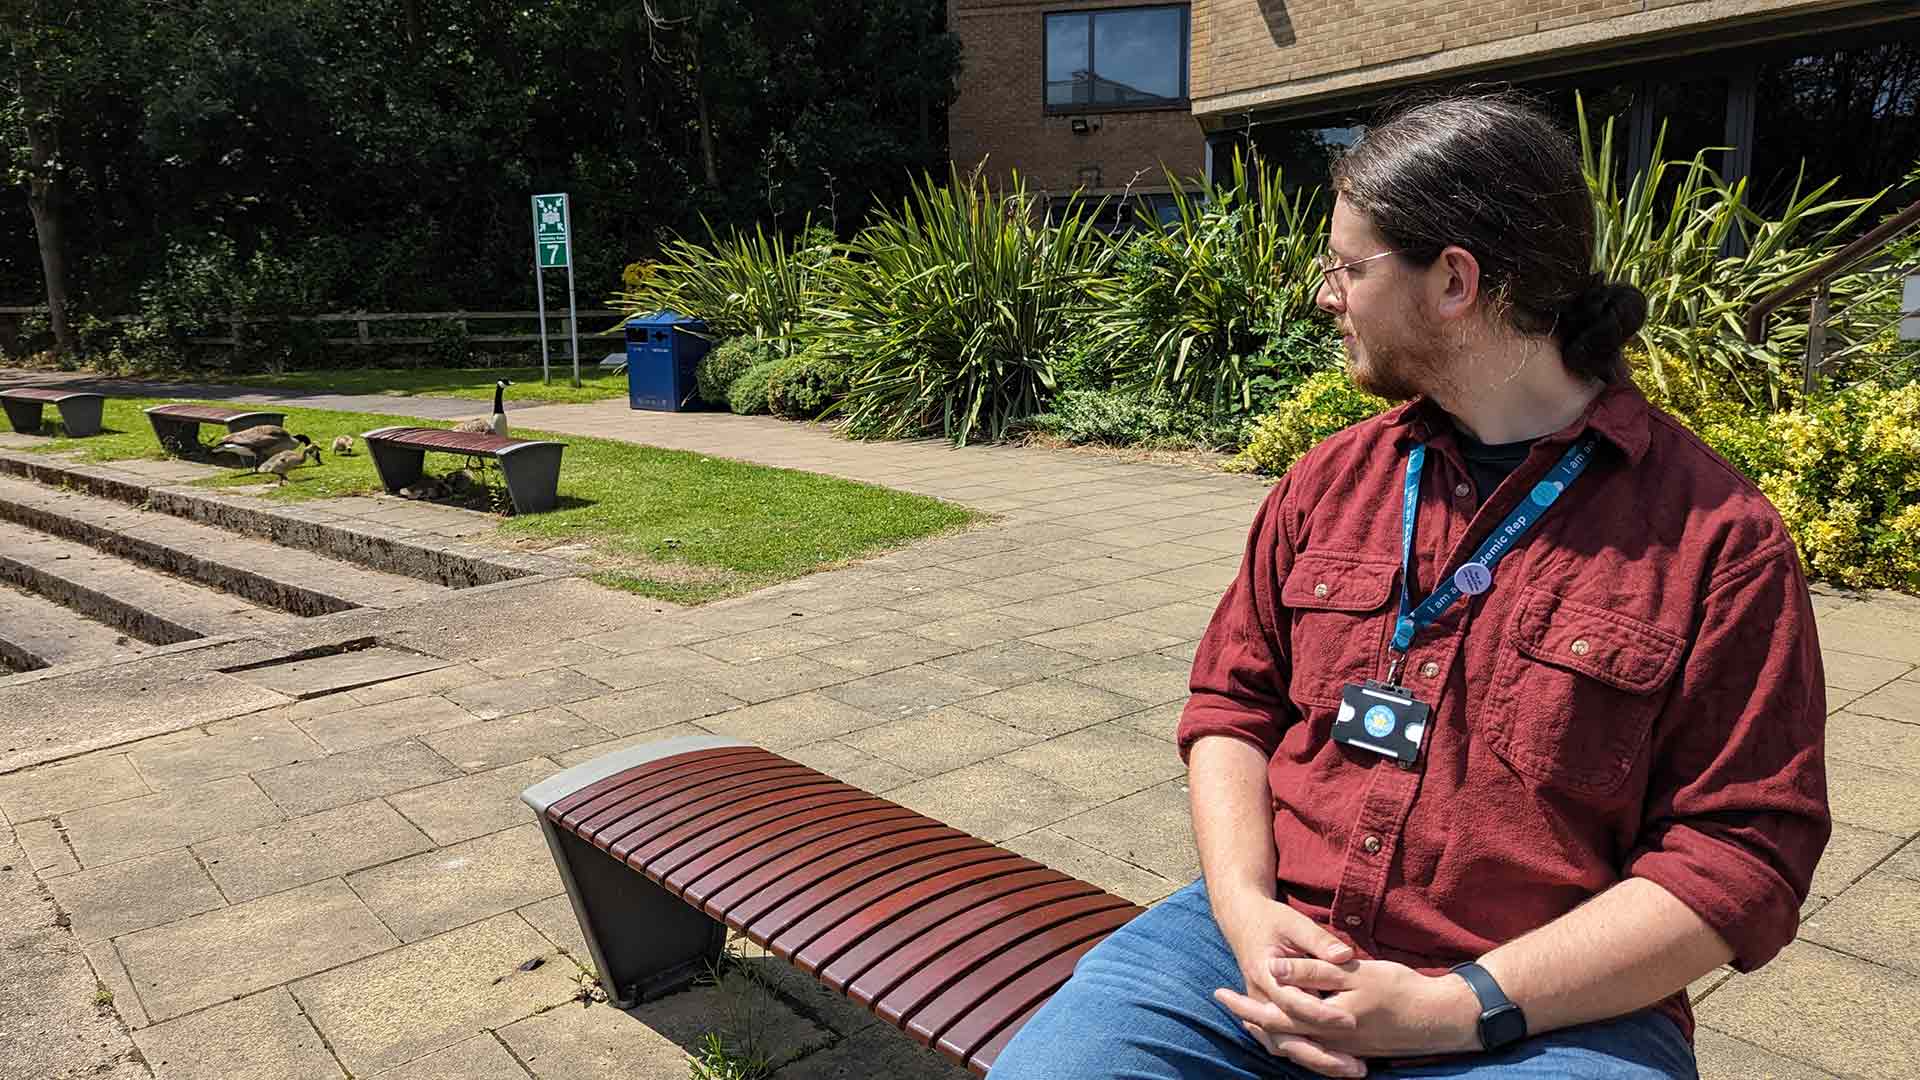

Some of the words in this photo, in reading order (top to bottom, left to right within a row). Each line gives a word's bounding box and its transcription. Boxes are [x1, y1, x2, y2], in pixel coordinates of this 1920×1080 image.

[547, 244, 559, 265] 7
[1570, 454, 1584, 469] am
[1427, 605, 1435, 614] I
[1435, 594, 1450, 609] am
[1480, 536, 1508, 566] demic
[1504, 515, 1527, 536] Rep
